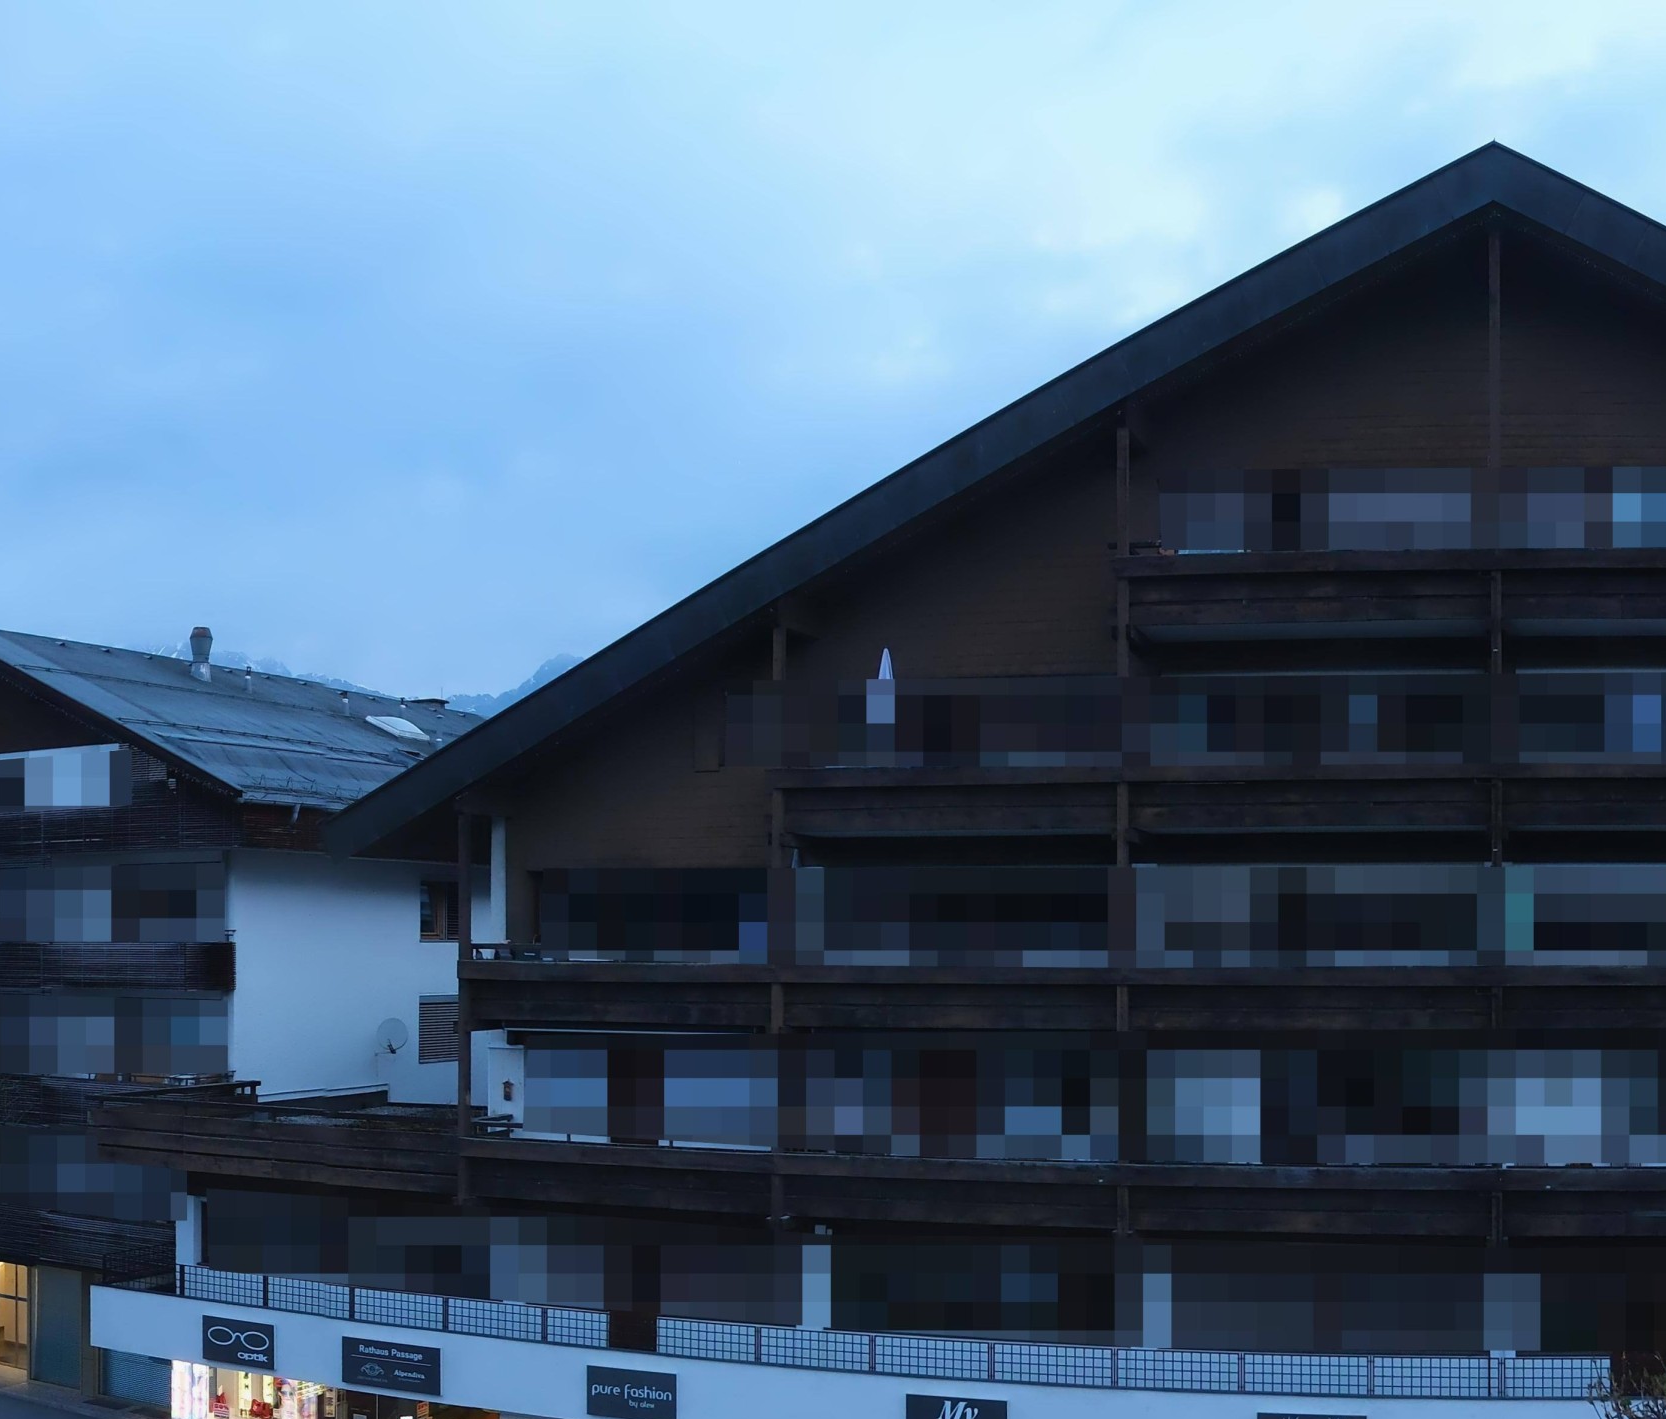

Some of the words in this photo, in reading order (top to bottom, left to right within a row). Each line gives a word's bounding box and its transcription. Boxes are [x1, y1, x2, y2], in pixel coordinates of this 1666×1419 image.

[237, 1350, 269, 1363] optik
[358, 1344, 389, 1356] Rathaus
[391, 1348, 422, 1361] Passage
[591, 1383, 621, 1396] pure
[624, 1383, 672, 1401] fashion
